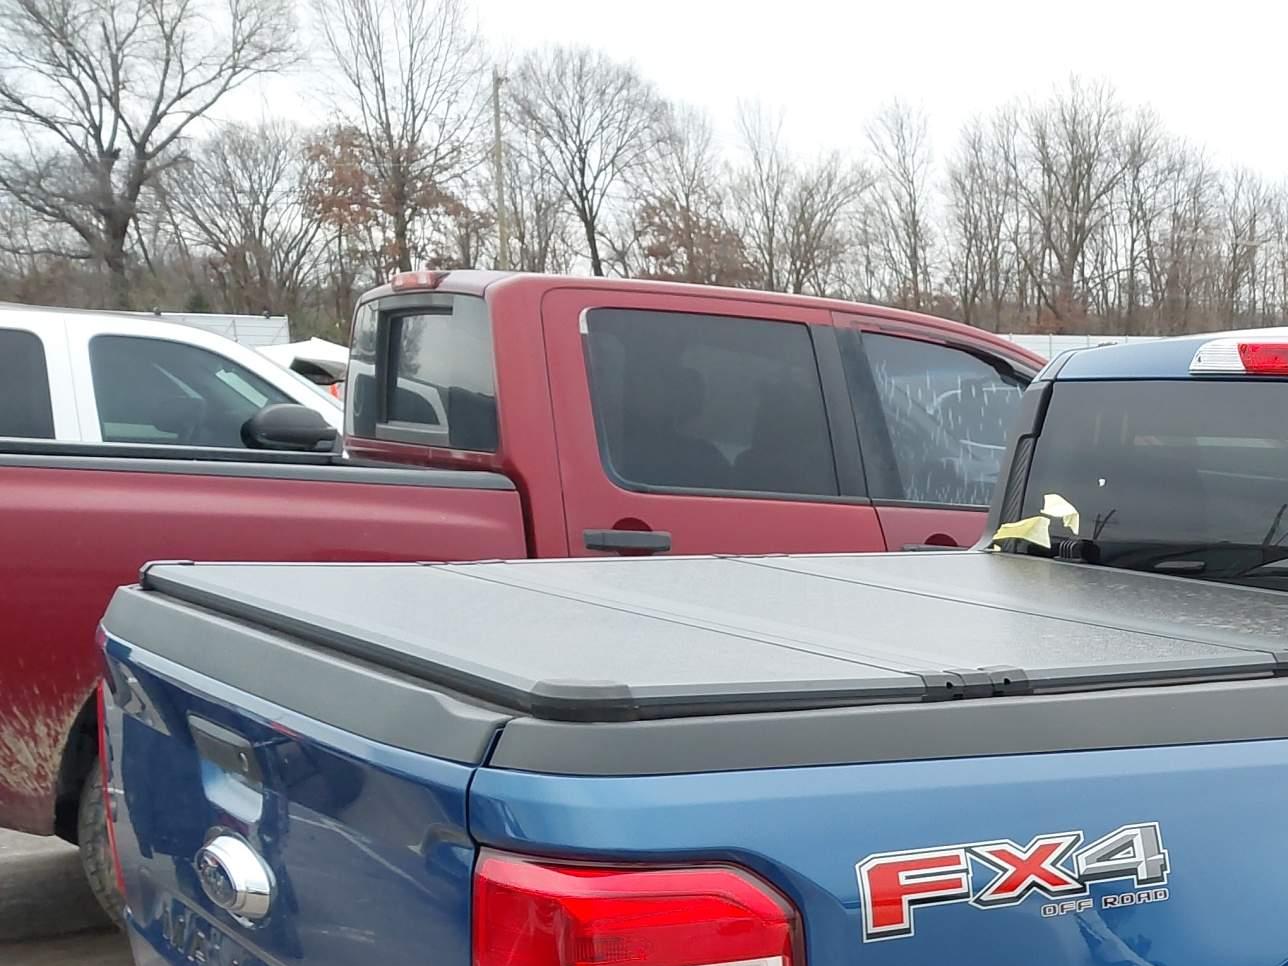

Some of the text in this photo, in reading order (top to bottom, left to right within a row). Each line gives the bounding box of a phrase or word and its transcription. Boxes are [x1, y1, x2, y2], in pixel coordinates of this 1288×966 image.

[855, 821, 1170, 943] FX4
[1041, 888, 1170, 917] OFF ROAD
